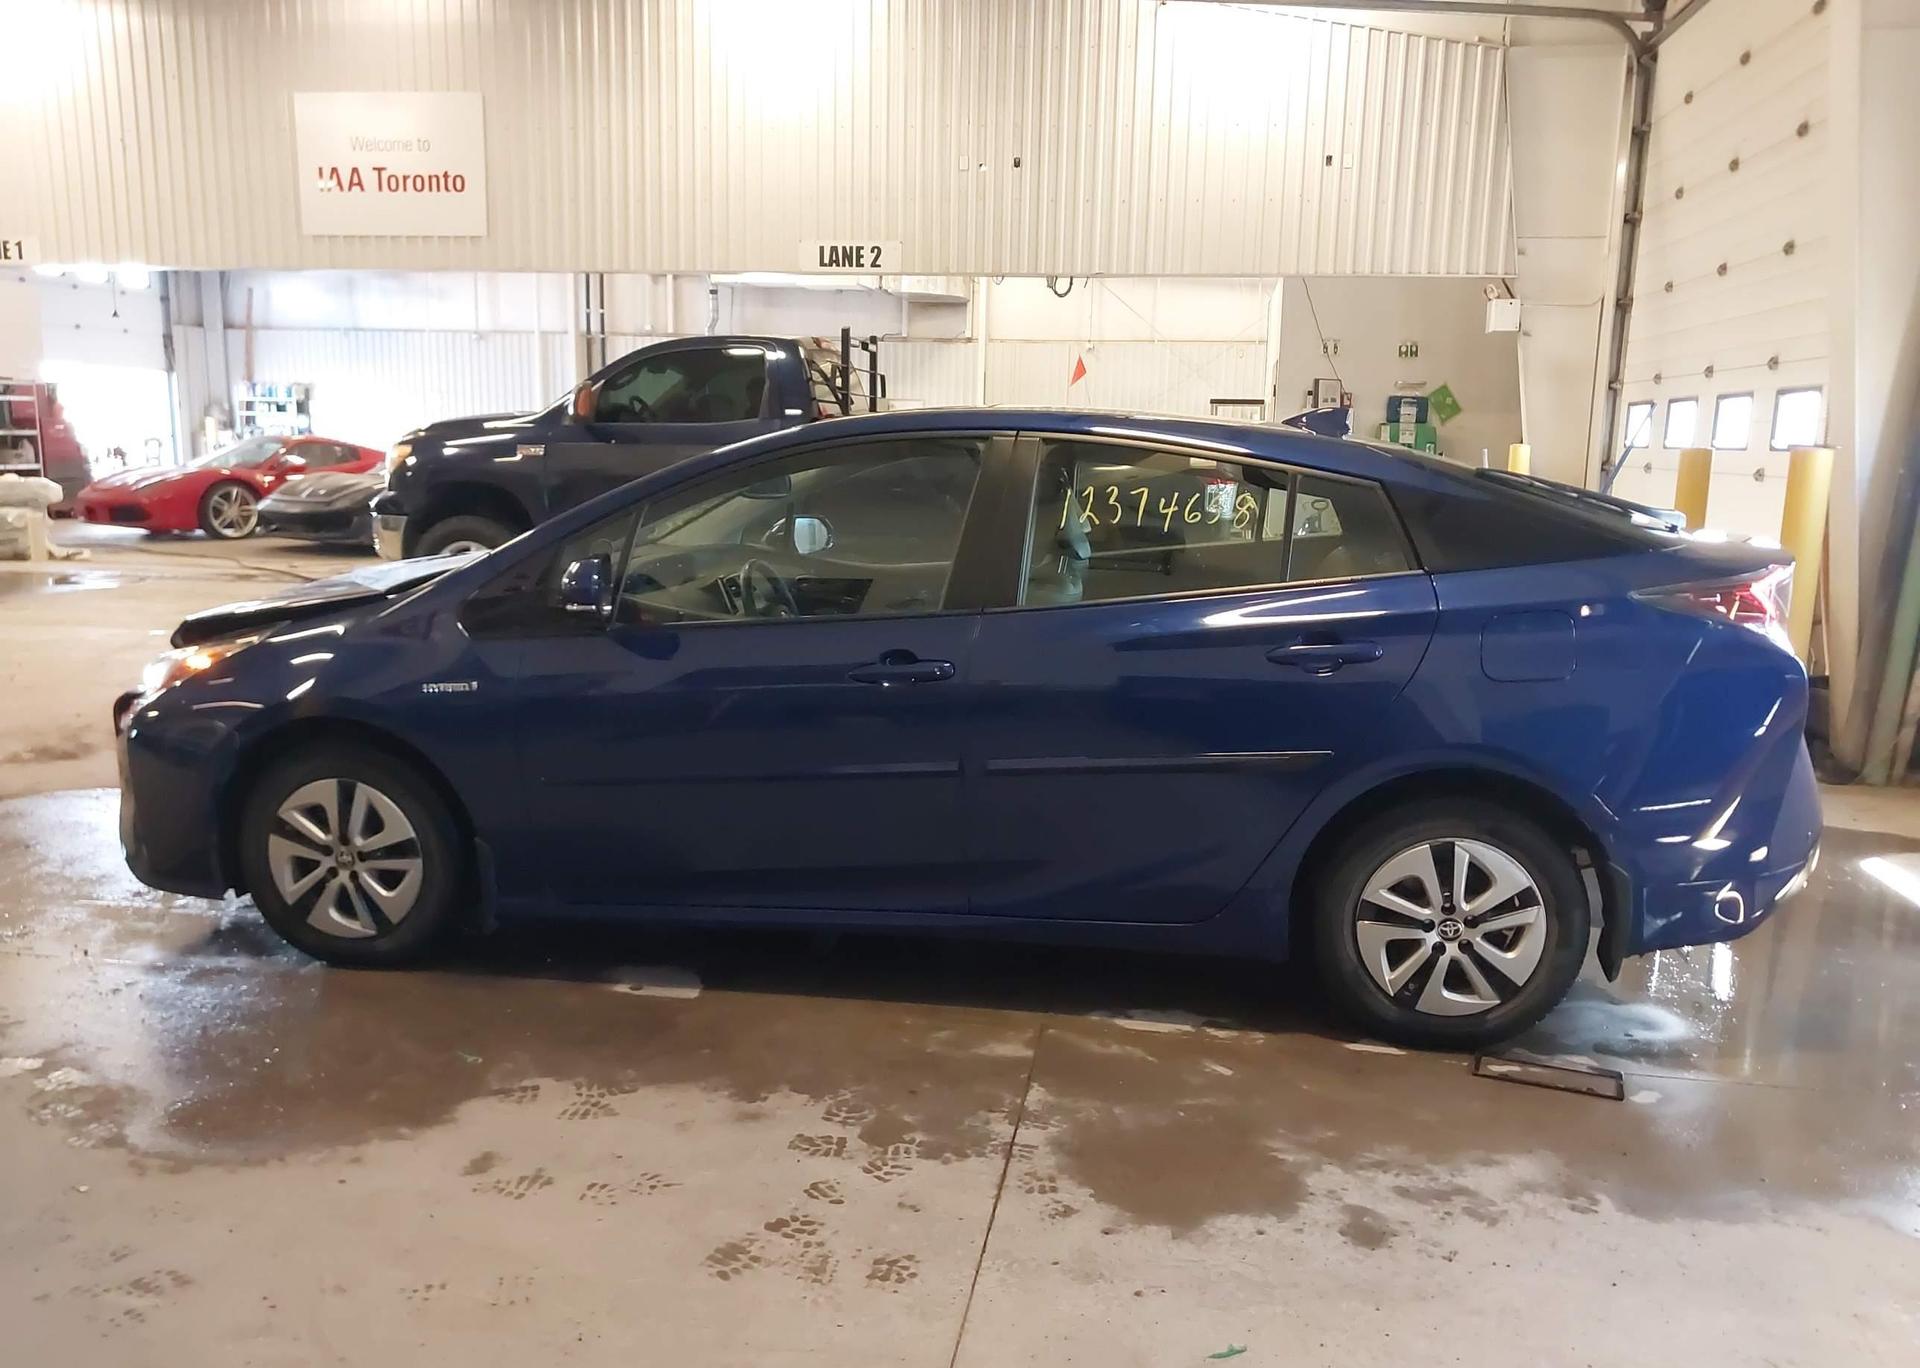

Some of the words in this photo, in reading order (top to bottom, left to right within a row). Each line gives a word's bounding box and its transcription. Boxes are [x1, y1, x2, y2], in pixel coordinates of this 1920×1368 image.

[350, 136, 413, 152] Welcome
[417, 137, 431, 152] to
[372, 167, 466, 193] Toronto
[14, 240, 23, 260] 1
[819, 245, 865, 268] LANE
[870, 245, 882, 268] 2
